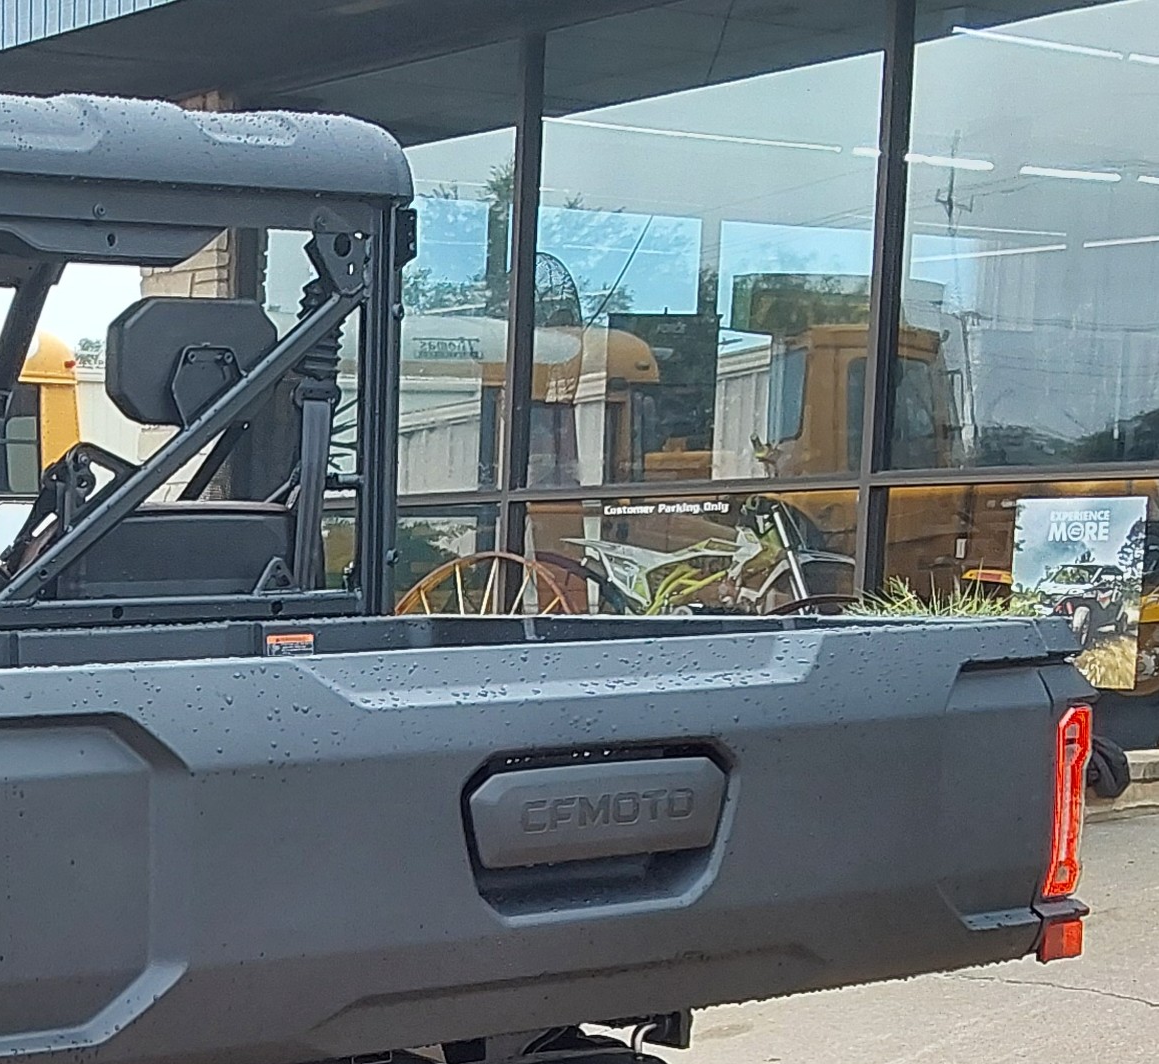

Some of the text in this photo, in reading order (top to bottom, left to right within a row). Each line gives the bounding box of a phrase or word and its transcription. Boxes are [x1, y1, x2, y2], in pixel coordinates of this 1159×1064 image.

[603, 500, 730, 516] Customer Parking Only
[1049, 509, 1111, 522] EXPERIENCE
[1047, 521, 1111, 542] MORE
[520, 787, 694, 835] CFMOTO
